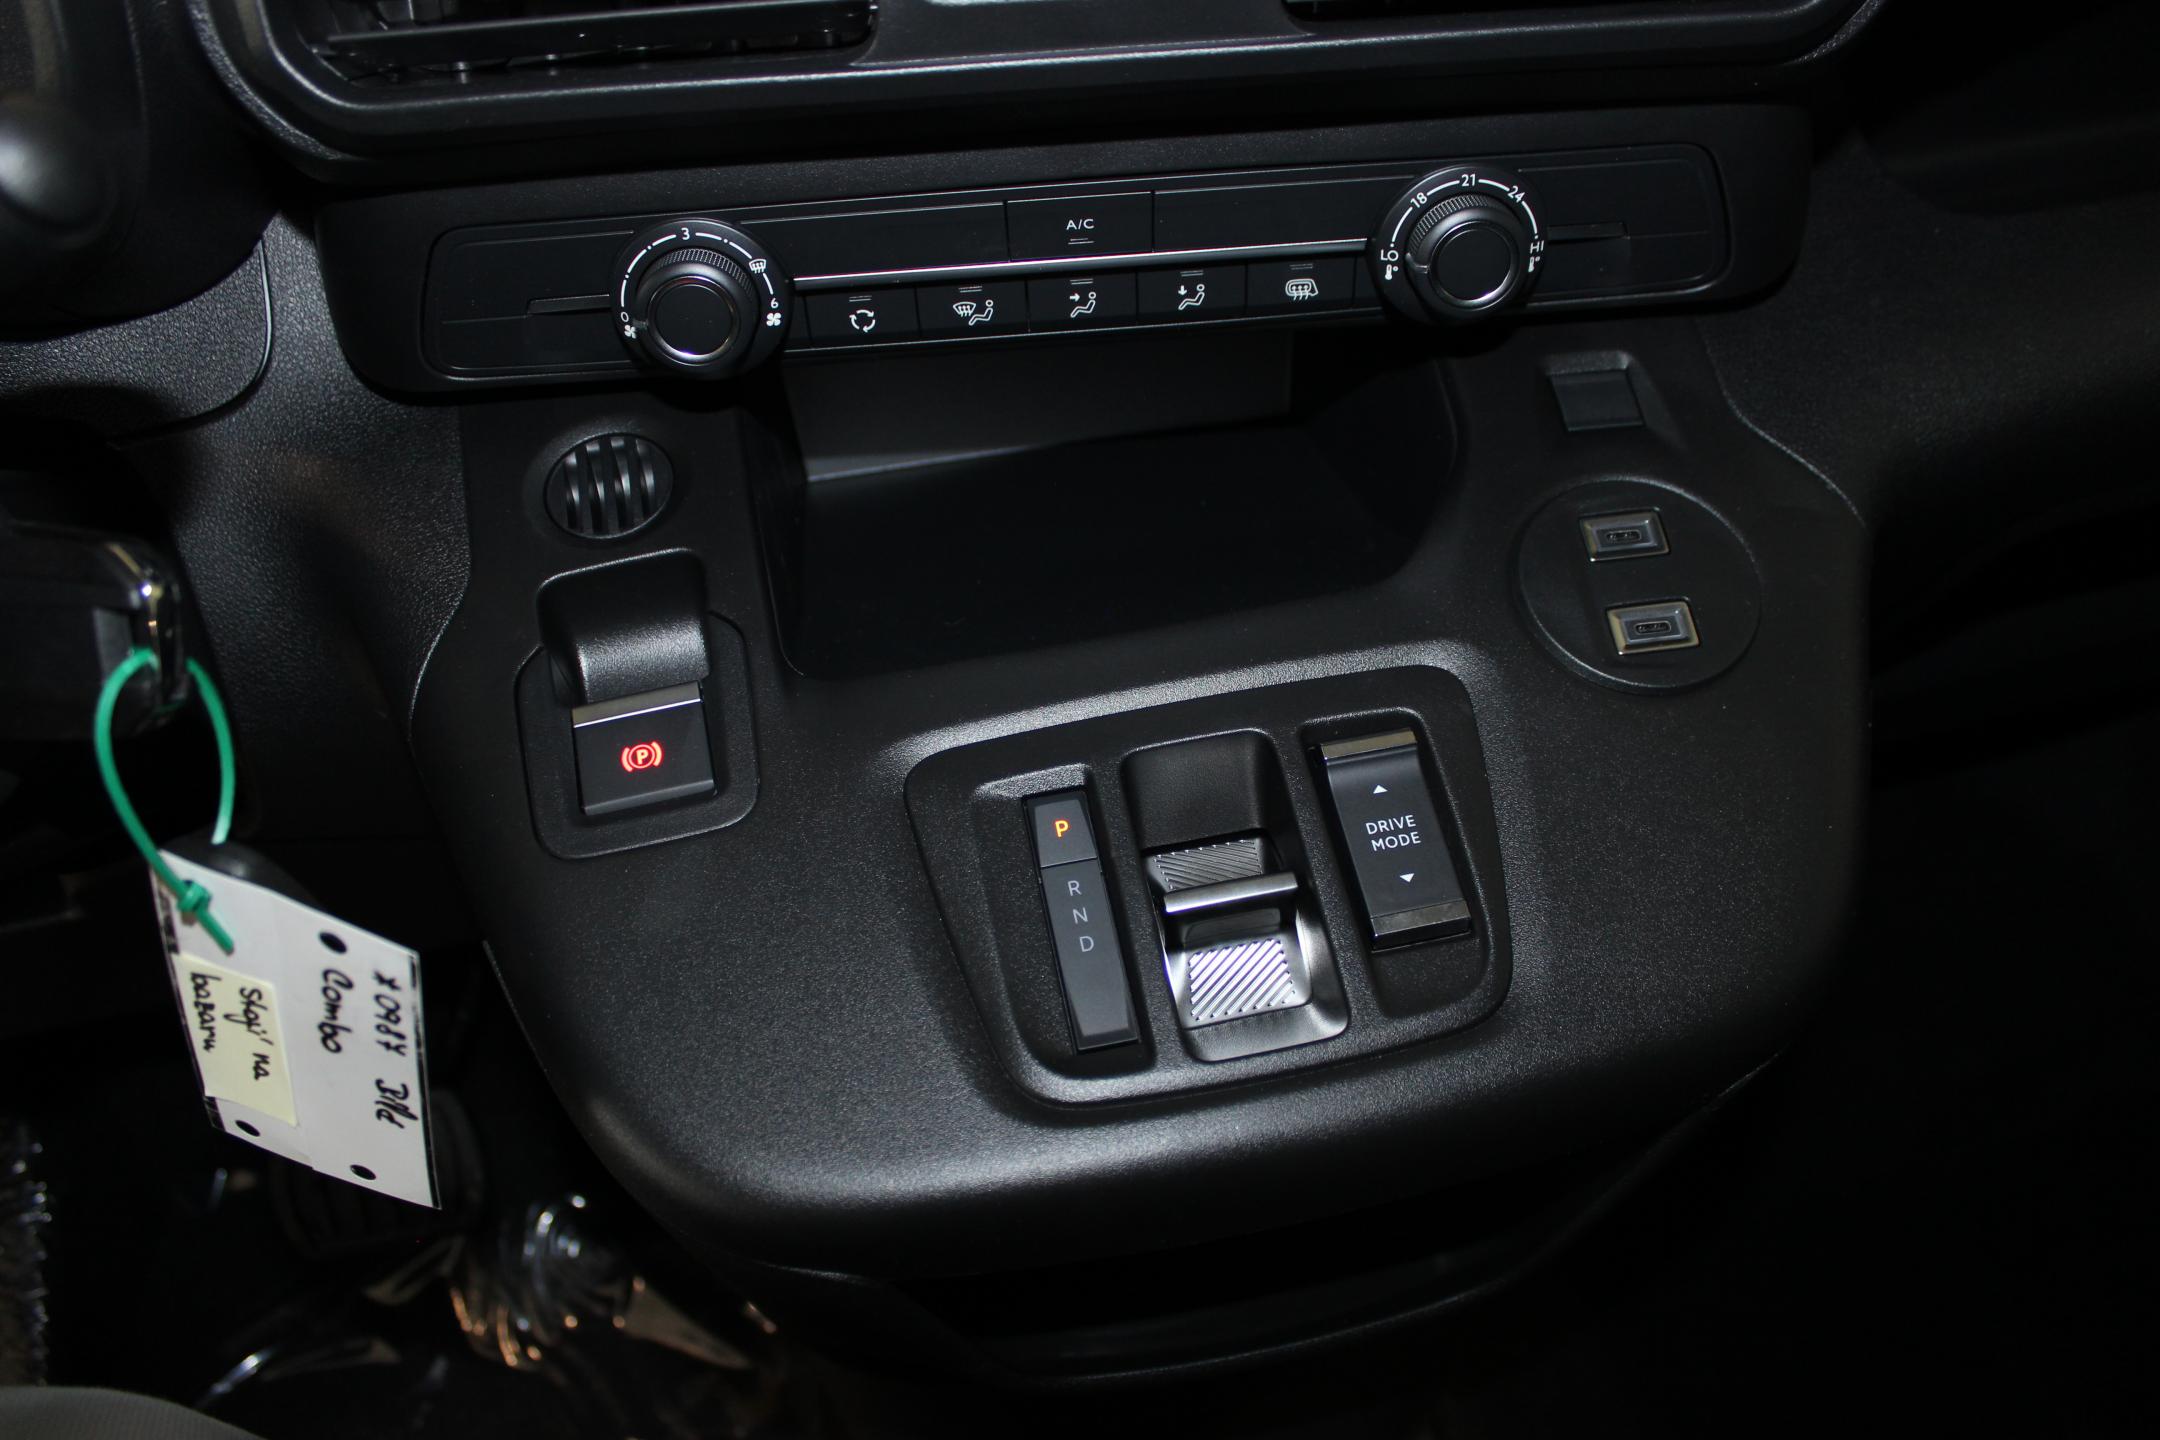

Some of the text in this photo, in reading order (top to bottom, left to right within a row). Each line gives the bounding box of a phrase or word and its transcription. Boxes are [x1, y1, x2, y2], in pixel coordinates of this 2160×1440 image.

[1461, 174, 1476, 187] 21
[1410, 192, 1428, 209] 18
[1507, 185, 1526, 203] 24
[1066, 218, 1095, 231] A/C
[681, 227, 691, 240] 3
[1380, 249, 1399, 261] LO
[1529, 240, 1545, 254] HI
[770, 298, 779, 309] 6
[1054, 820, 1070, 838] P
[1365, 814, 1417, 835] DRIVE
[1371, 831, 1422, 852] MODE
[1067, 880, 1082, 897] R
[1072, 907, 1089, 925] N
[1079, 936, 1095, 953] D
[318, 968, 354, 1054] Combo
[252, 1051, 271, 1081] na
